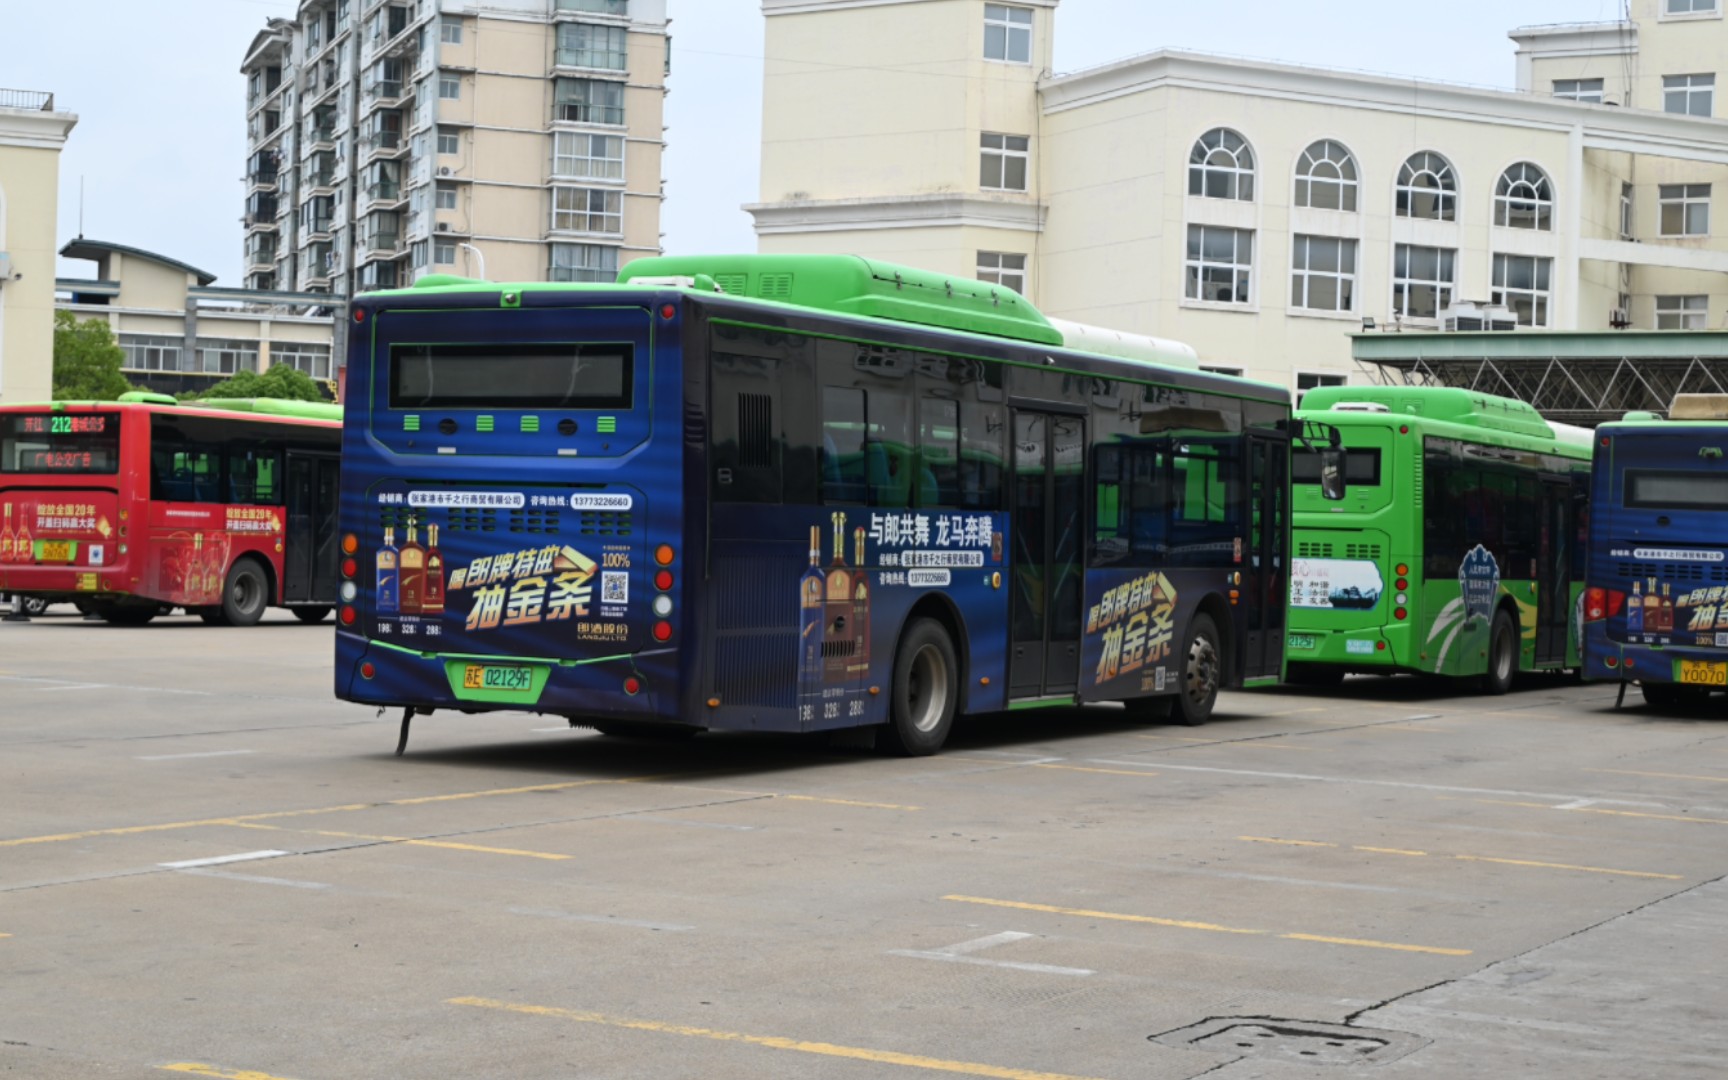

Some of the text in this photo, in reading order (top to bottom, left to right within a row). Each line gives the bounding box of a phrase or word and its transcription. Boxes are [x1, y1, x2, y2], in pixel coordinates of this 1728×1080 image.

[51, 416, 71, 432] 212
[869, 512, 993, 547] 与郎共舞 龙马奔腾
[602, 553, 630, 567] 100%
[466, 572, 593, 631] 抽金条
[1095, 603, 1173, 684] 抽金条
[486, 669, 530, 688] 02129F
